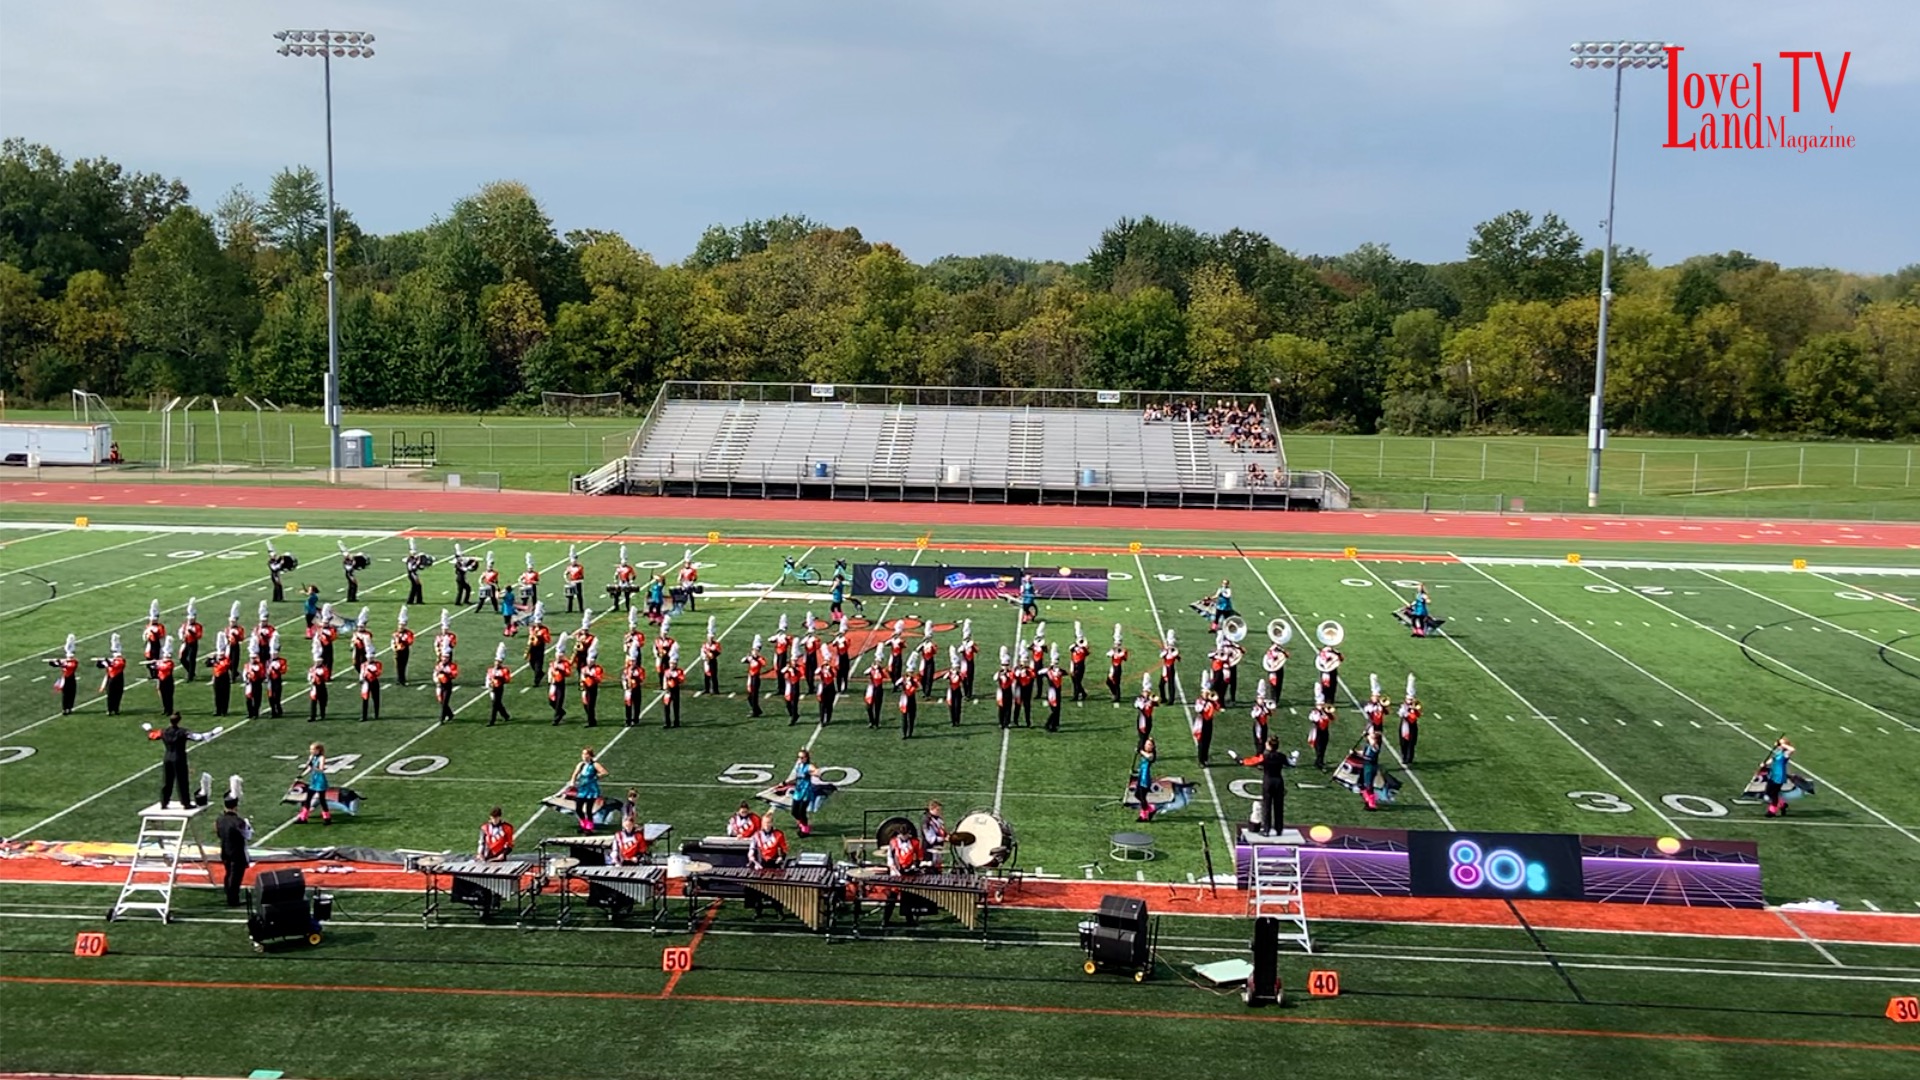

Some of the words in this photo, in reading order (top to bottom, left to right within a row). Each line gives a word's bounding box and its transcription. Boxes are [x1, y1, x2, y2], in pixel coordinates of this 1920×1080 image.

[870, 567, 919, 593] 80s
[717, 763, 862, 787] 50
[1448, 839, 1547, 892] 80s
[78, 935, 102, 954] 40
[666, 950, 688, 970] 50
[1313, 974, 1336, 994] 40
[1896, 1000, 1918, 1020] 30
